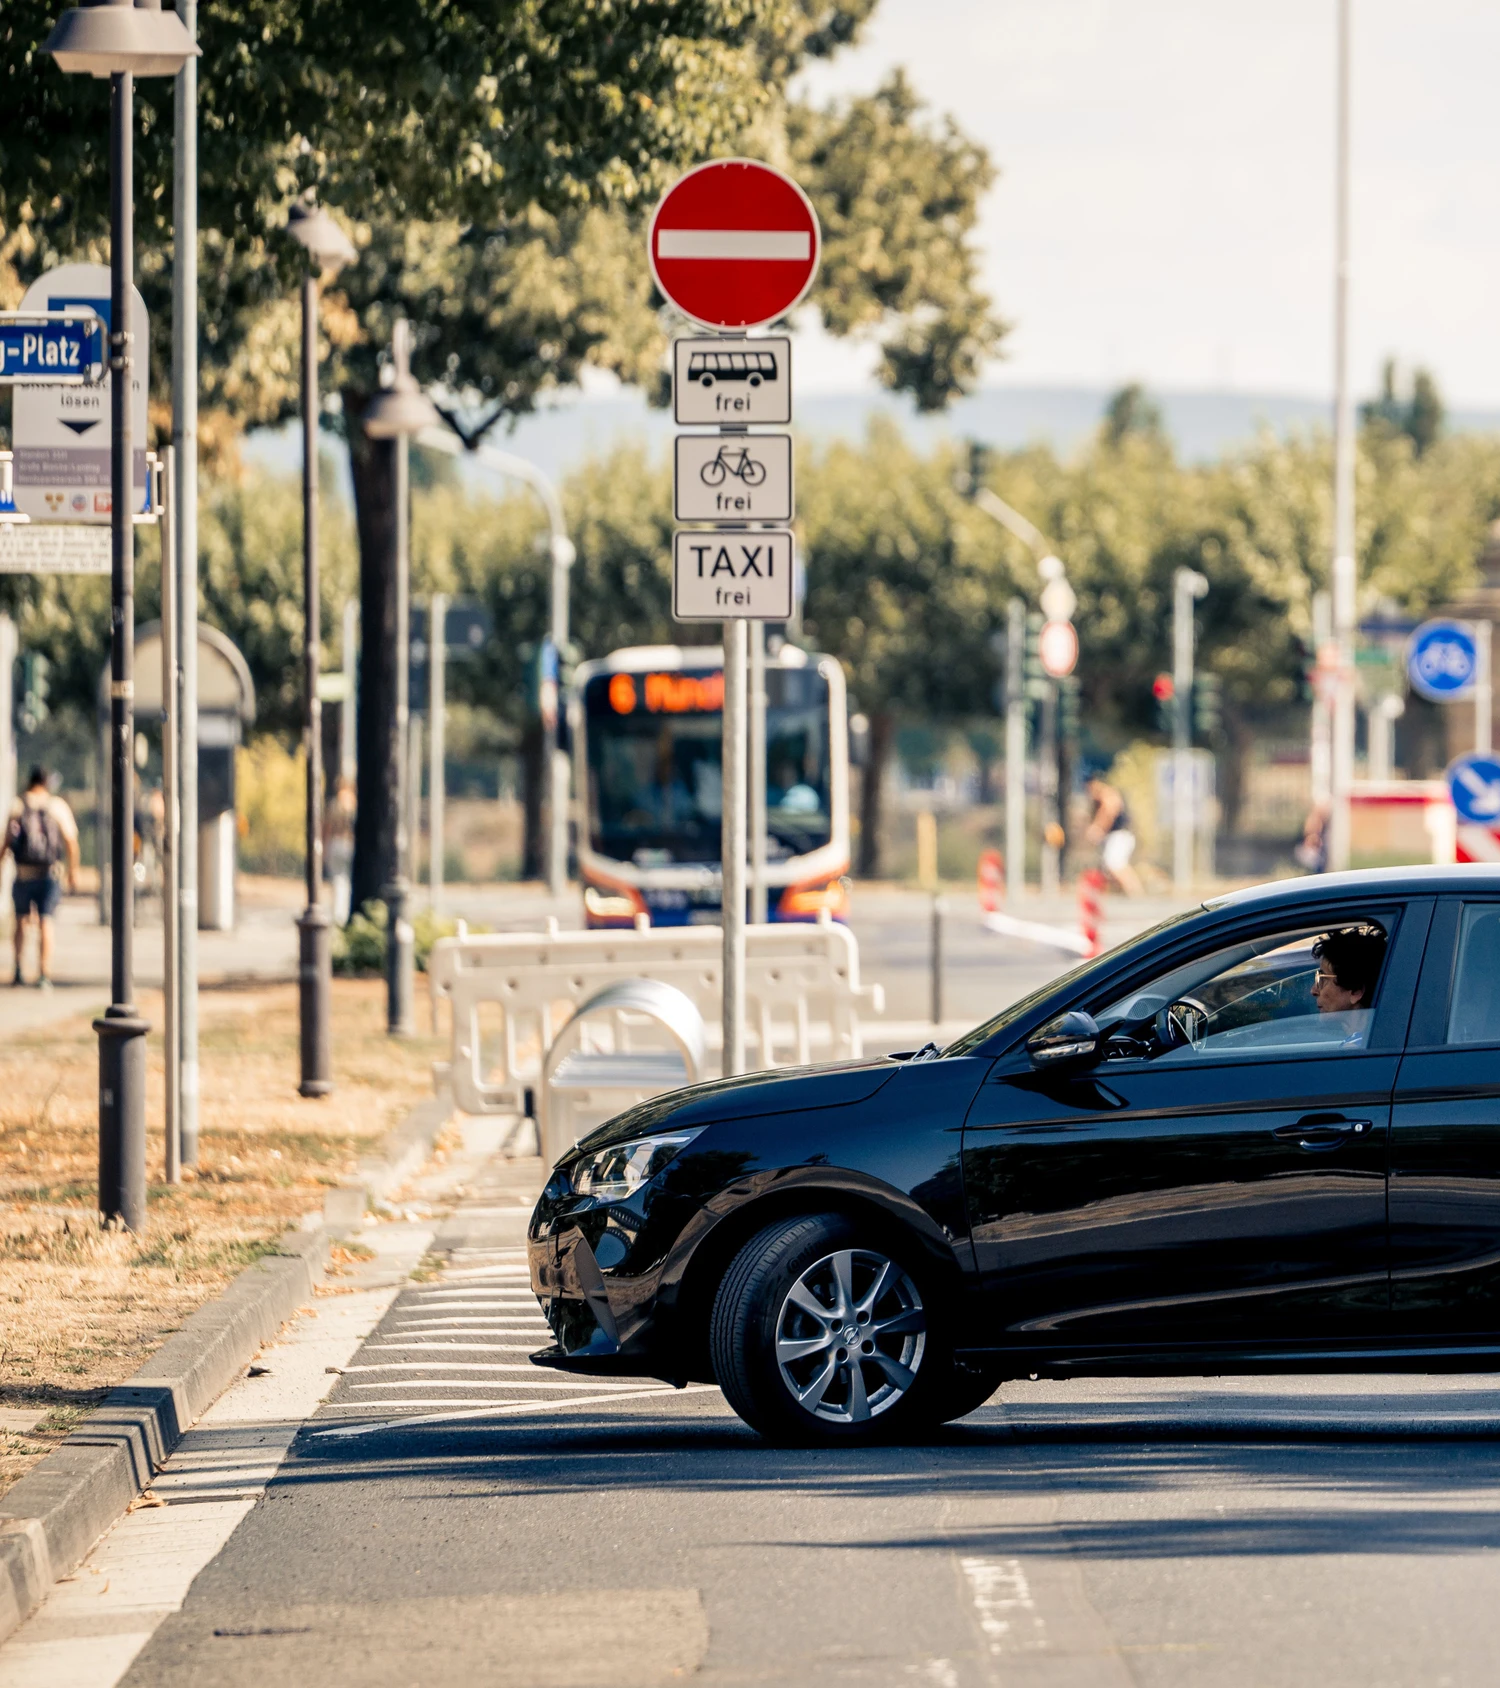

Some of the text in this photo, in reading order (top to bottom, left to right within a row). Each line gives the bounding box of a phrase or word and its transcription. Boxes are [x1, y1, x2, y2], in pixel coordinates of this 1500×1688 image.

[60, 392, 100, 408] lösen
[715, 393, 751, 411] frei
[716, 492, 751, 510] frei
[689, 546, 774, 578] TAXI
[715, 586, 751, 605] frei
